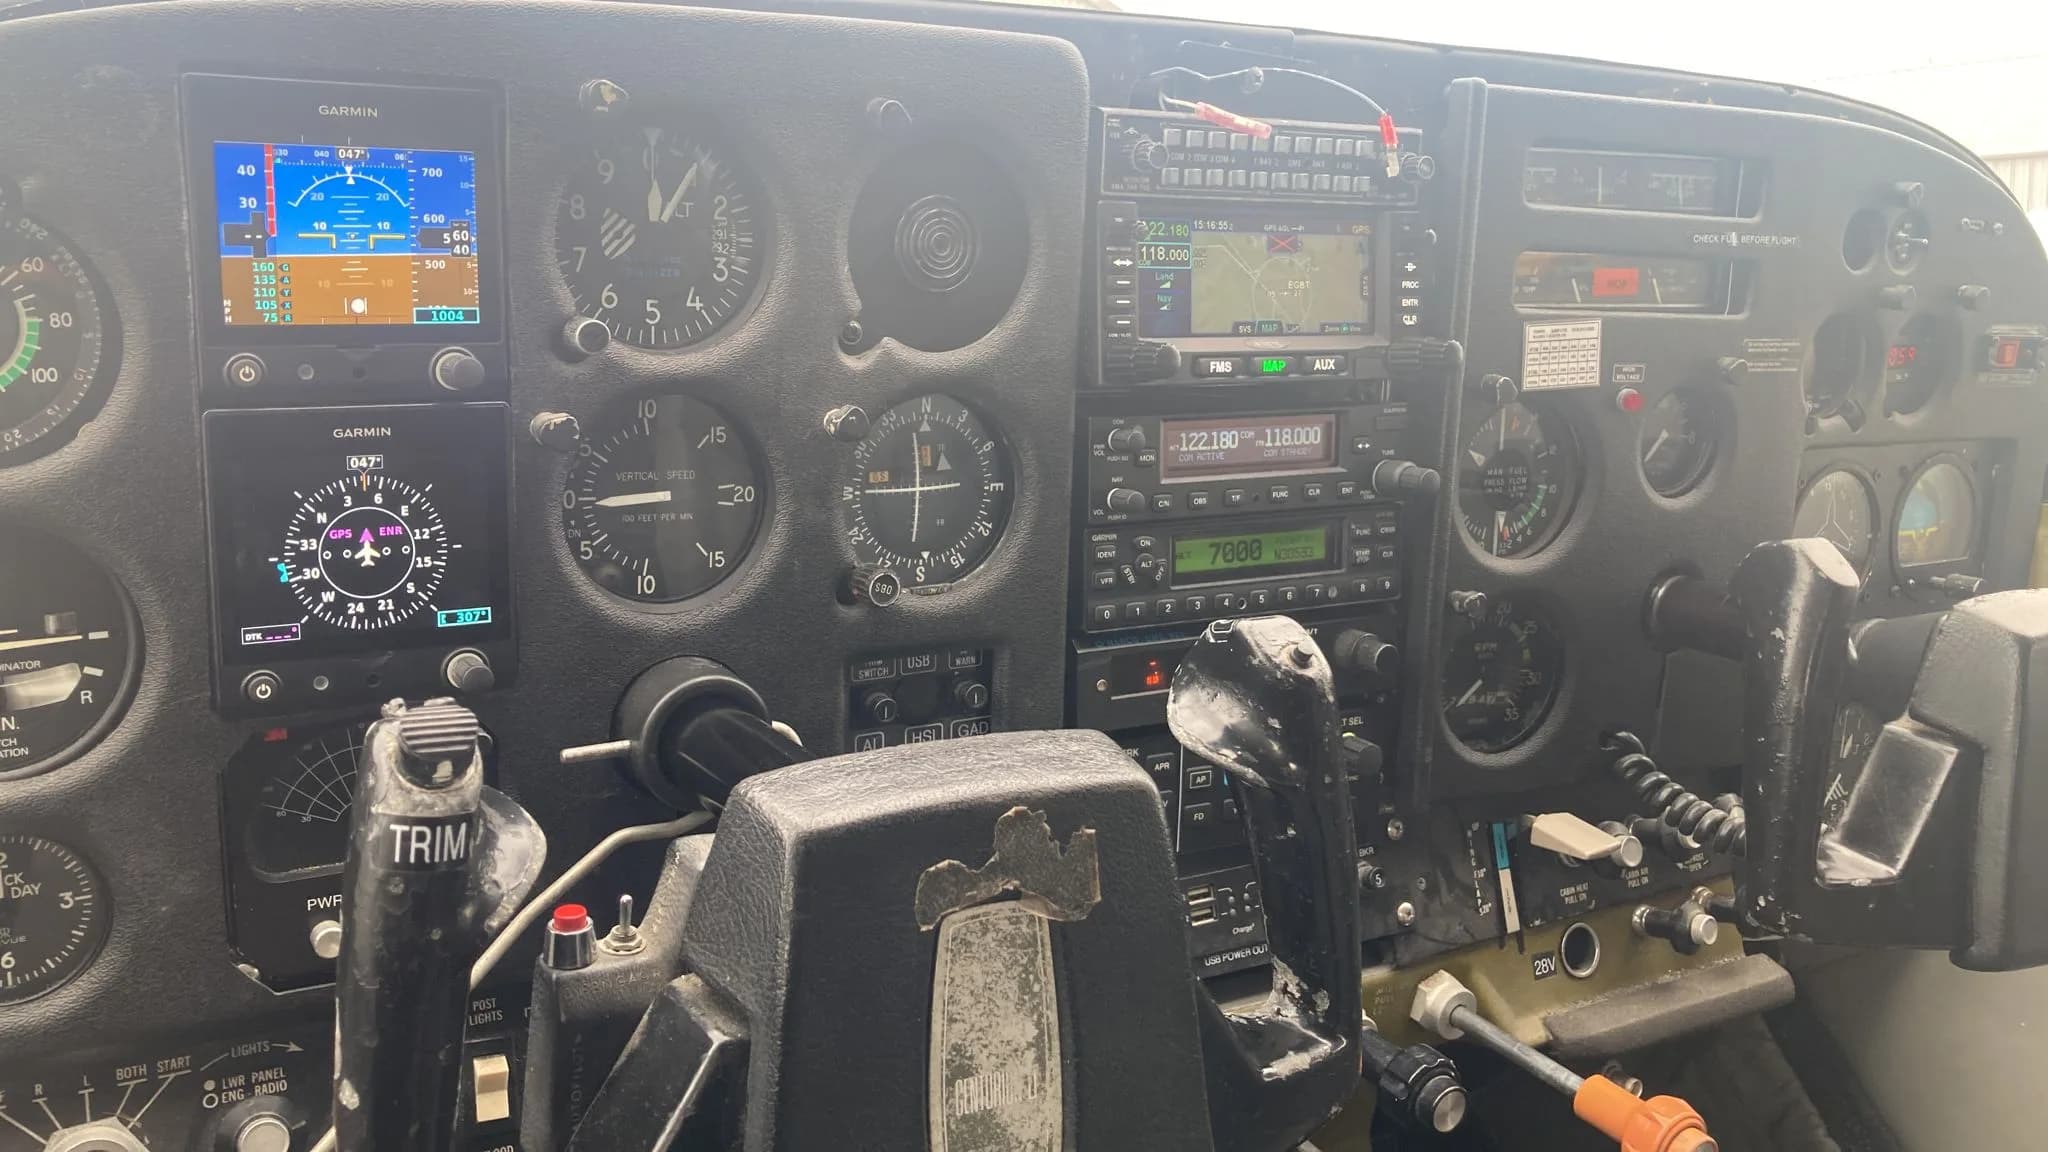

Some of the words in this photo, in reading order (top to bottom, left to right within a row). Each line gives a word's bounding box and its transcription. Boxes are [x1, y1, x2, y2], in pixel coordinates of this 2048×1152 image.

[318, 105, 378, 118] GARMIN
[314, 150, 329, 158] 040
[237, 165, 256, 176] 40
[422, 168, 443, 177] 700
[597, 159, 614, 184] 9
[310, 192, 324, 201] 20
[376, 192, 390, 201] 20
[239, 198, 257, 208] 30
[570, 194, 586, 220] 8
[713, 195, 728, 220] 2
[424, 214, 445, 223] 600
[312, 222, 327, 230] 10
[377, 222, 390, 230] 10
[1694, 234, 1718, 243] CHECK
[1741, 235, 1769, 244] BEFORE
[453, 245, 470, 256] 40
[1141, 246, 1189, 260] 118.000
[22, 257, 44, 272] 60
[425, 260, 446, 269] 500
[572, 246, 586, 272] 7
[252, 262, 275, 272] 160
[712, 256, 729, 282] 3
[253, 275, 276, 285] 135
[1156, 272, 1174, 280] Land
[254, 288, 276, 297] 110
[601, 284, 618, 309] 6
[686, 286, 704, 310] 4
[255, 300, 278, 310] 105
[1402, 299, 1418, 307] ENTR
[430, 311, 464, 322] 1004
[645, 300, 660, 324] 5
[50, 312, 72, 328] 80
[263, 313, 278, 323] 75
[1402, 316, 1417, 325] CLR
[1210, 361, 1232, 372] FMS
[1262, 360, 1287, 372] MAP
[1314, 359, 1336, 370] AUX
[32, 367, 58, 383] 100
[639, 400, 657, 418] 10
[922, 396, 931, 414] N
[958, 410, 969, 424] 3
[333, 427, 392, 438] GARMIN
[710, 426, 726, 443] 15
[1265, 426, 1320, 446] 118.000
[983, 440, 995, 452] 6
[1180, 431, 1238, 450] 122.180
[1178, 454, 1194, 462] COM
[616, 472, 659, 482] VERTICAL
[667, 471, 696, 480] SPEED
[990, 482, 1004, 492] E
[1308, 488, 1320, 496] CLR
[374, 494, 382, 504] 6
[563, 490, 576, 509] 0
[734, 486, 754, 502] 20
[344, 496, 352, 507] 3
[401, 505, 408, 516] E
[316, 512, 327, 523] N
[638, 514, 656, 522] FEET
[661, 514, 676, 522] PER
[379, 526, 403, 536] ENR
[414, 528, 430, 539] 12
[568, 529, 582, 538] DN
[977, 520, 992, 537] 12
[329, 529, 352, 540] GPS
[848, 526, 864, 545] 24
[300, 540, 318, 550] 33
[580, 541, 593, 560] 5
[1209, 538, 1262, 565] 7000
[416, 557, 432, 568] 15
[709, 551, 726, 568] 15
[950, 552, 966, 568] 15
[302, 568, 320, 579] 30
[916, 566, 925, 582] S
[406, 582, 415, 593] S
[637, 575, 656, 594] 10
[874, 582, 893, 595] OBS
[1360, 584, 1366, 592] 8
[1384, 580, 1390, 589] 9
[321, 592, 335, 602] W
[1260, 594, 1264, 603] 5
[1287, 592, 1292, 600] 6
[1314, 589, 1320, 597] 7
[378, 600, 394, 610] 21
[1195, 601, 1200, 610] 3
[1224, 598, 1229, 606] 4
[347, 603, 364, 614] 24
[1165, 604, 1172, 612] 2
[1104, 610, 1110, 619] 0
[245, 633, 262, 641] DTK
[908, 655, 930, 668] USB
[858, 668, 888, 679] SWITCH
[80, 690, 93, 704] R
[1504, 708, 1520, 721] 35
[1348, 716, 1364, 726] SEL
[958, 722, 989, 738] GAD
[912, 730, 936, 743] HSI
[1154, 762, 1170, 771] APR
[1196, 776, 1206, 784] AP
[1194, 813, 1204, 821] FD
[390, 822, 467, 864] TRIM
[1359, 846, 1374, 857] BKR
[1375, 874, 1382, 885] 5
[11, 882, 41, 899] DAY
[1560, 887, 1575, 897] CABIN
[58, 891, 74, 909] 3
[0, 951, 15, 969] 6
[1205, 954, 1221, 966] USB
[1222, 948, 1250, 962] POWER
[1252, 944, 1268, 956] OUT
[1534, 957, 1556, 975] 28V
[473, 998, 496, 1011] POST
[469, 1010, 503, 1026] LIGHTS
[230, 1041, 270, 1058] LIGHTS
[156, 1056, 191, 1073] START
[116, 1064, 147, 1081] BOTH
[83, 1075, 91, 1086] L
[222, 1075, 245, 1090] LWR
[252, 1067, 286, 1084] PANEL
[34, 1084, 43, 1096] R
